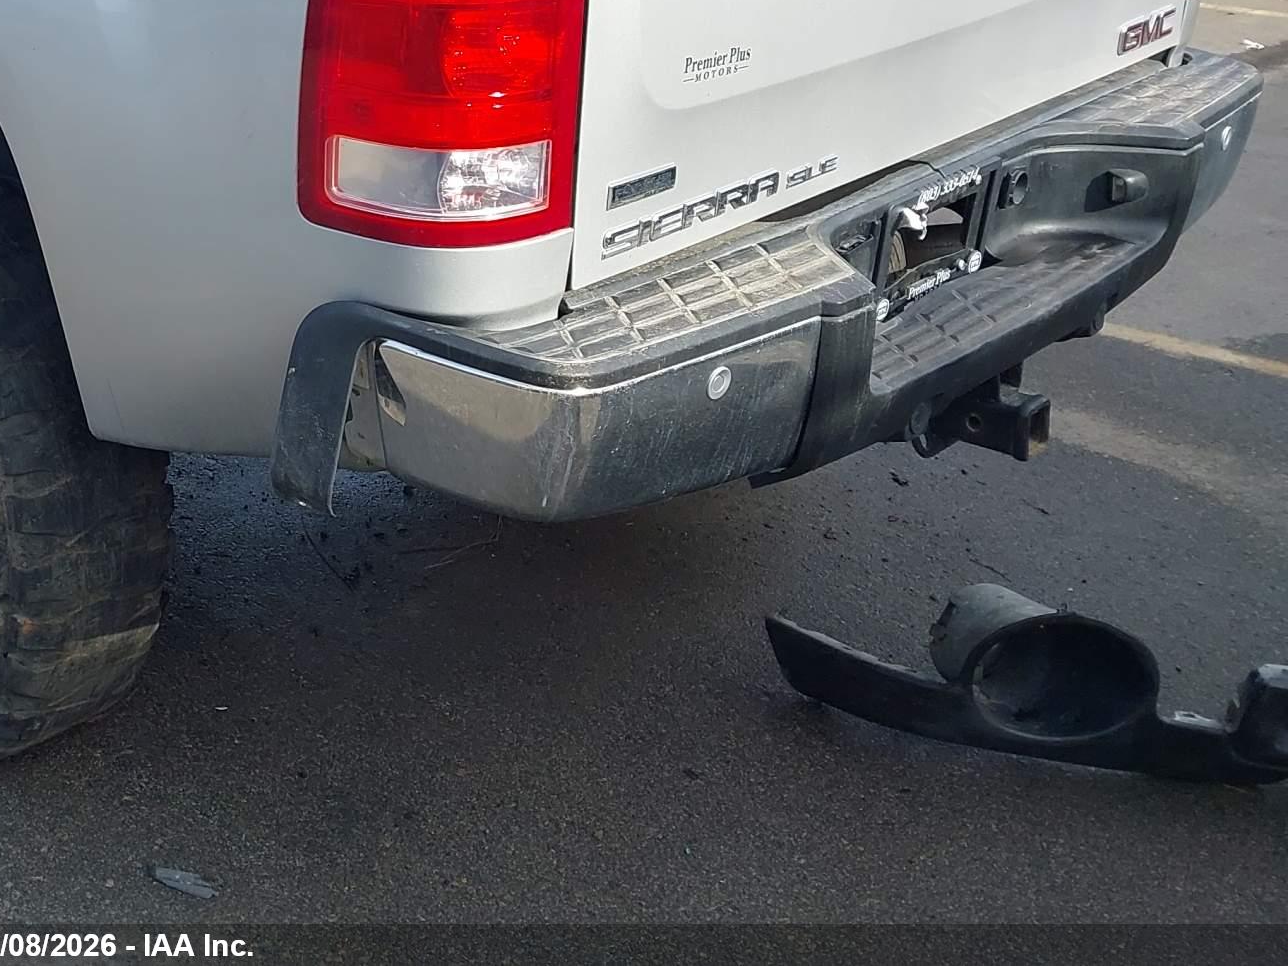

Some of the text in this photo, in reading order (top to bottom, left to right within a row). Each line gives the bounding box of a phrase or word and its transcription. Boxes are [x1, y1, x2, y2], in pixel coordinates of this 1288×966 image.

[1116, 7, 1177, 56] GMC
[684, 46, 752, 74] Premier Plus
[694, 64, 738, 83] MOTORS
[601, 170, 780, 261] SIERRA
[785, 155, 840, 190] SLE
[907, 275, 936, 300] Premier
[935, 267, 952, 286] Plus
